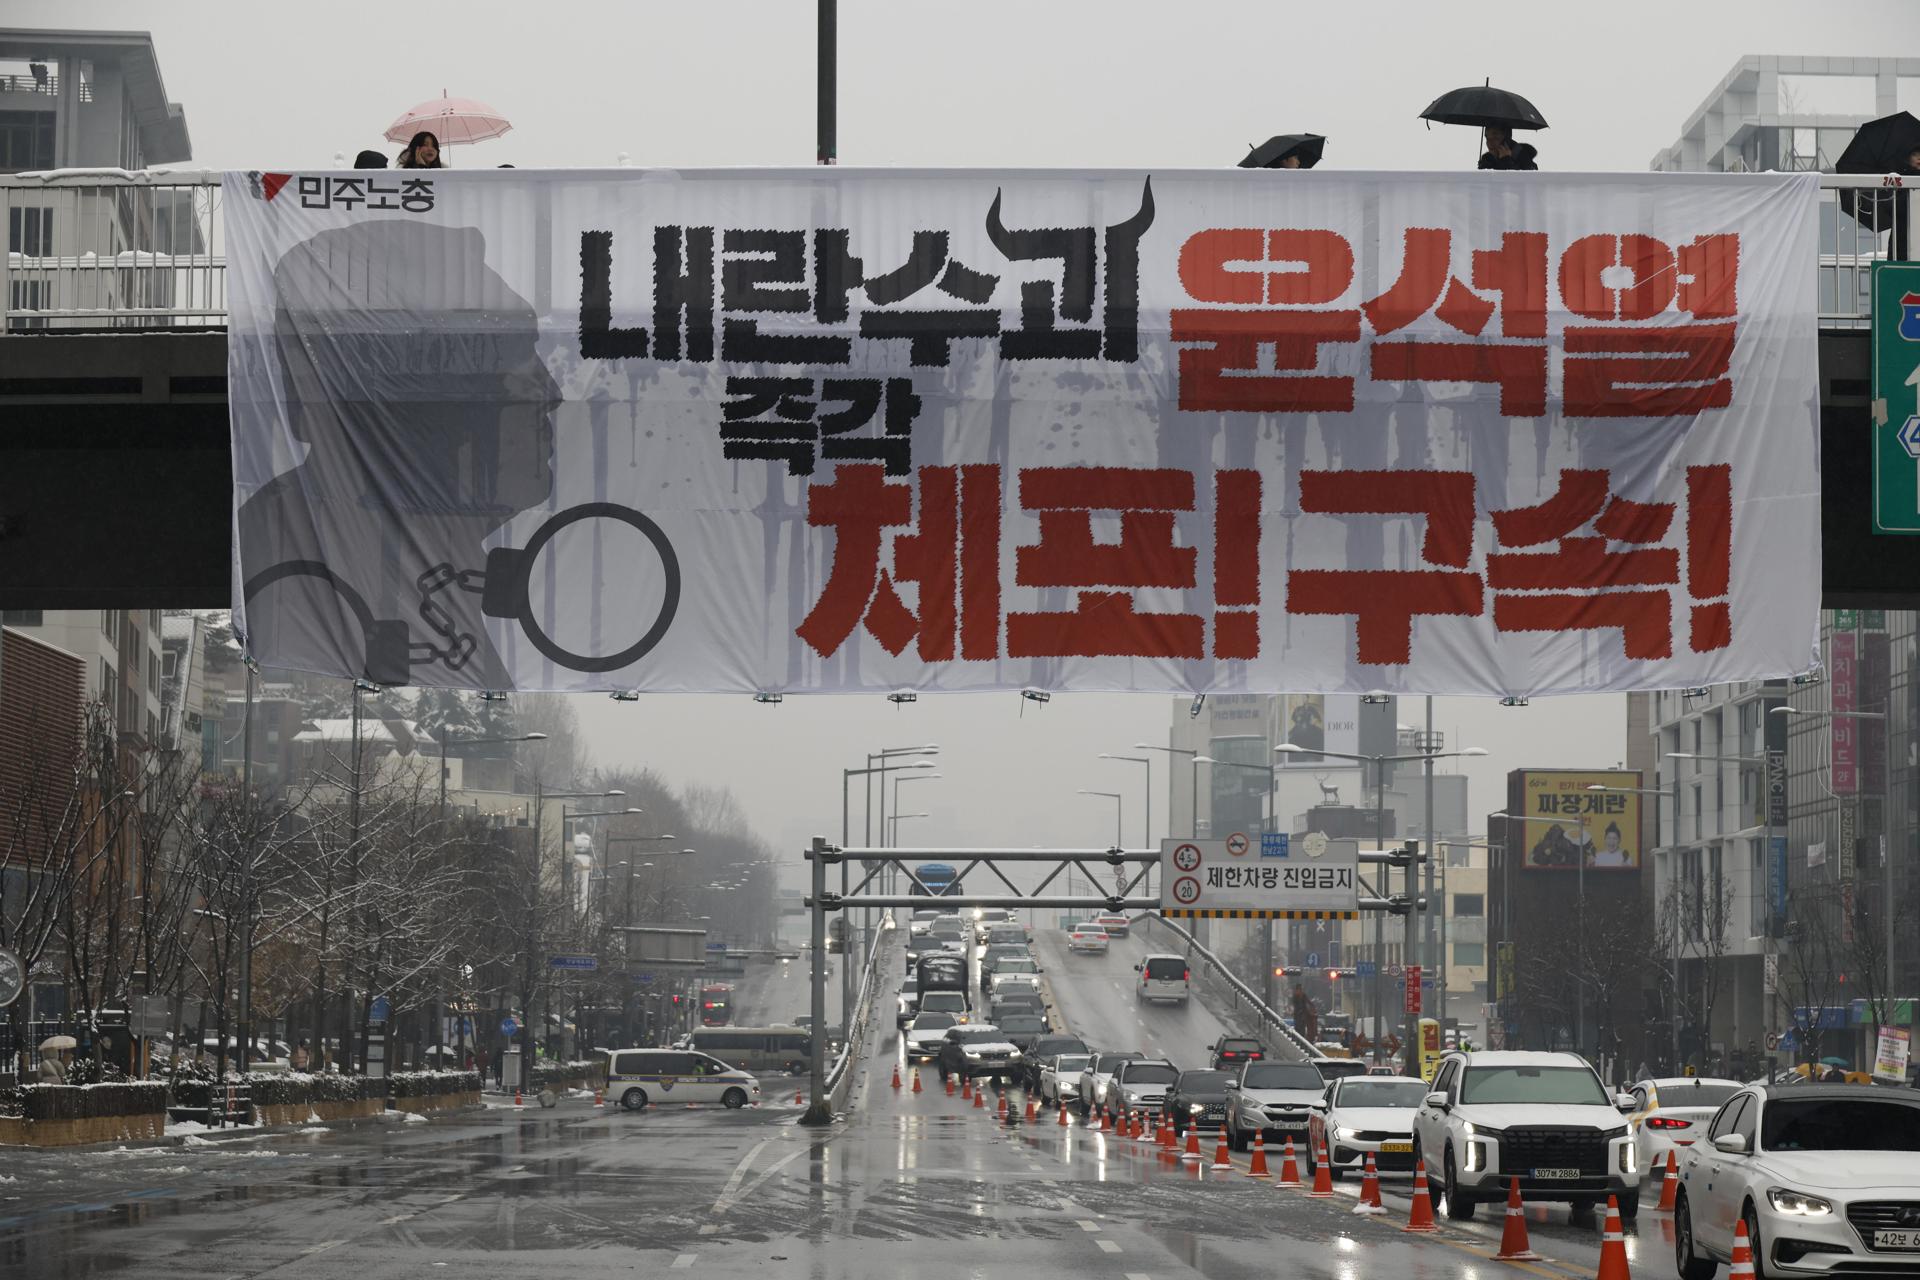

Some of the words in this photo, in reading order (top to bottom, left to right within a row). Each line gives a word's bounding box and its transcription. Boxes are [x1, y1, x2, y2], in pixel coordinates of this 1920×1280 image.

[299, 177, 434, 213] 민주노총
[580, 174, 1155, 367] 내란수괴
[1170, 227, 1740, 417] 윤석열
[720, 377, 921, 476] 즉각
[795, 463, 1262, 662] 체포!
[1286, 463, 1732, 665] 구속!
[1327, 721, 1354, 732] DIOR
[1207, 867, 1278, 889] 제한차량
[1284, 867, 1352, 889] 진입금지
[1181, 886, 1193, 898] 20
[1558, 1169, 1579, 1178] 2886
[1881, 1233, 1906, 1246] 42보
